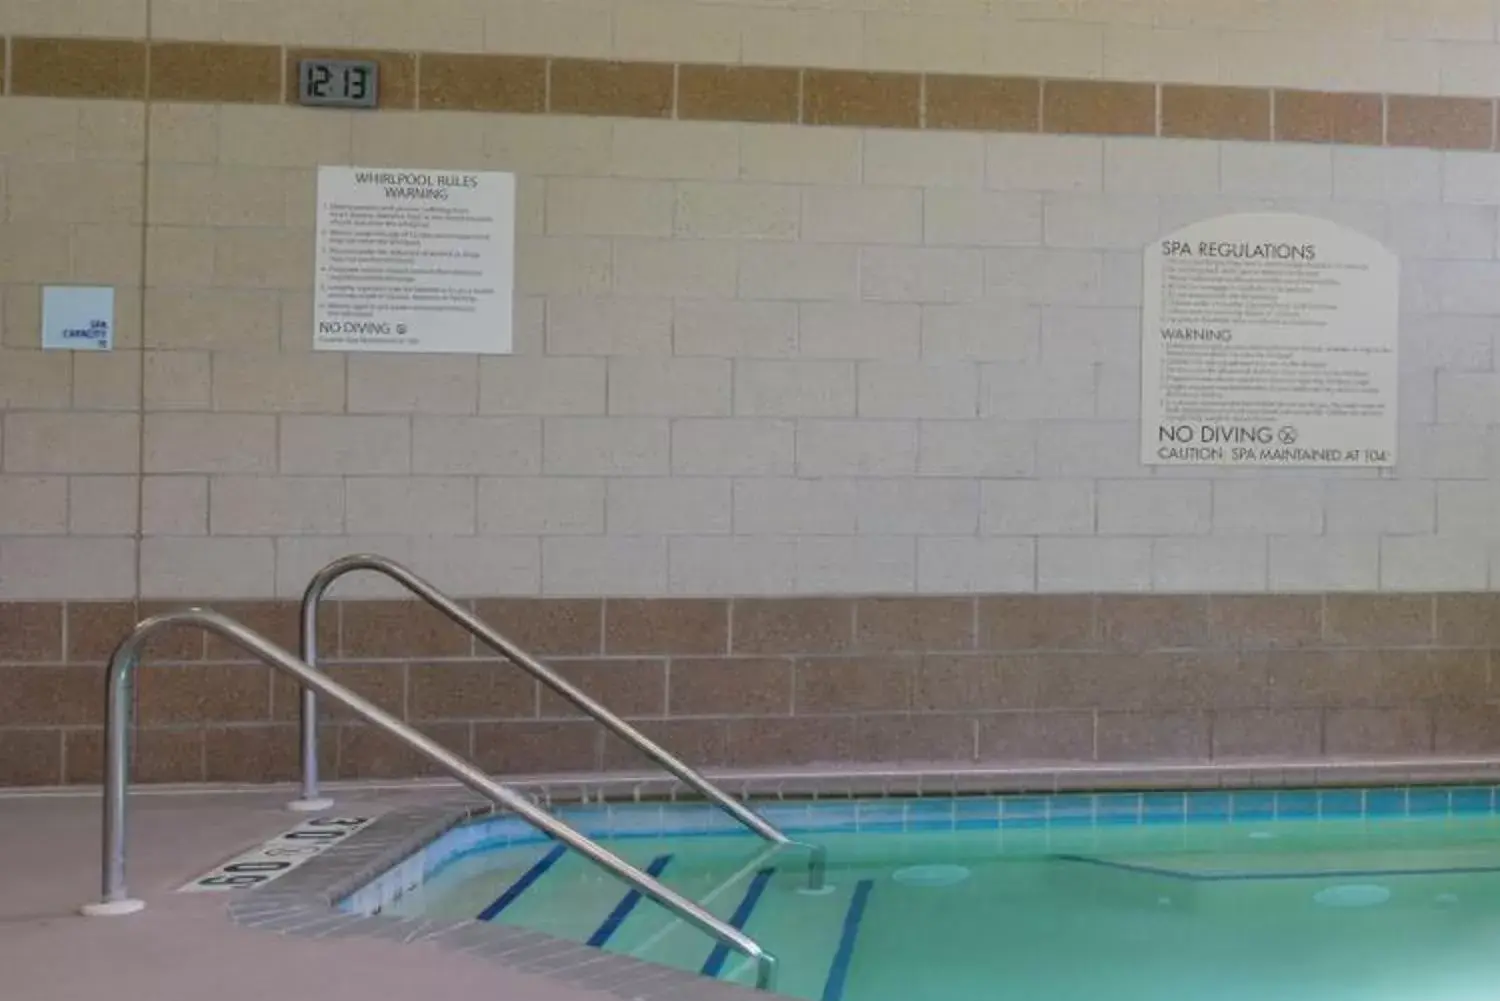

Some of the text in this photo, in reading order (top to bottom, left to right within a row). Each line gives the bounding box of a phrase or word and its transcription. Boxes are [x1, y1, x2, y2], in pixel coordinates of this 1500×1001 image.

[307, 66, 366, 99] 12:13
[355, 172, 479, 188] WHIRLPOOL RULES
[384, 186, 448, 200] WARNING
[1161, 240, 1316, 260] SPA REGULATIONS
[319, 322, 390, 335] NO DIVING
[1160, 328, 1232, 342] WARNING
[1158, 425, 1273, 444] NO DIVING
[1231, 447, 1256, 461] SPA
[1259, 447, 1341, 462] MAINTAINED
[1344, 449, 1360, 462] AT
